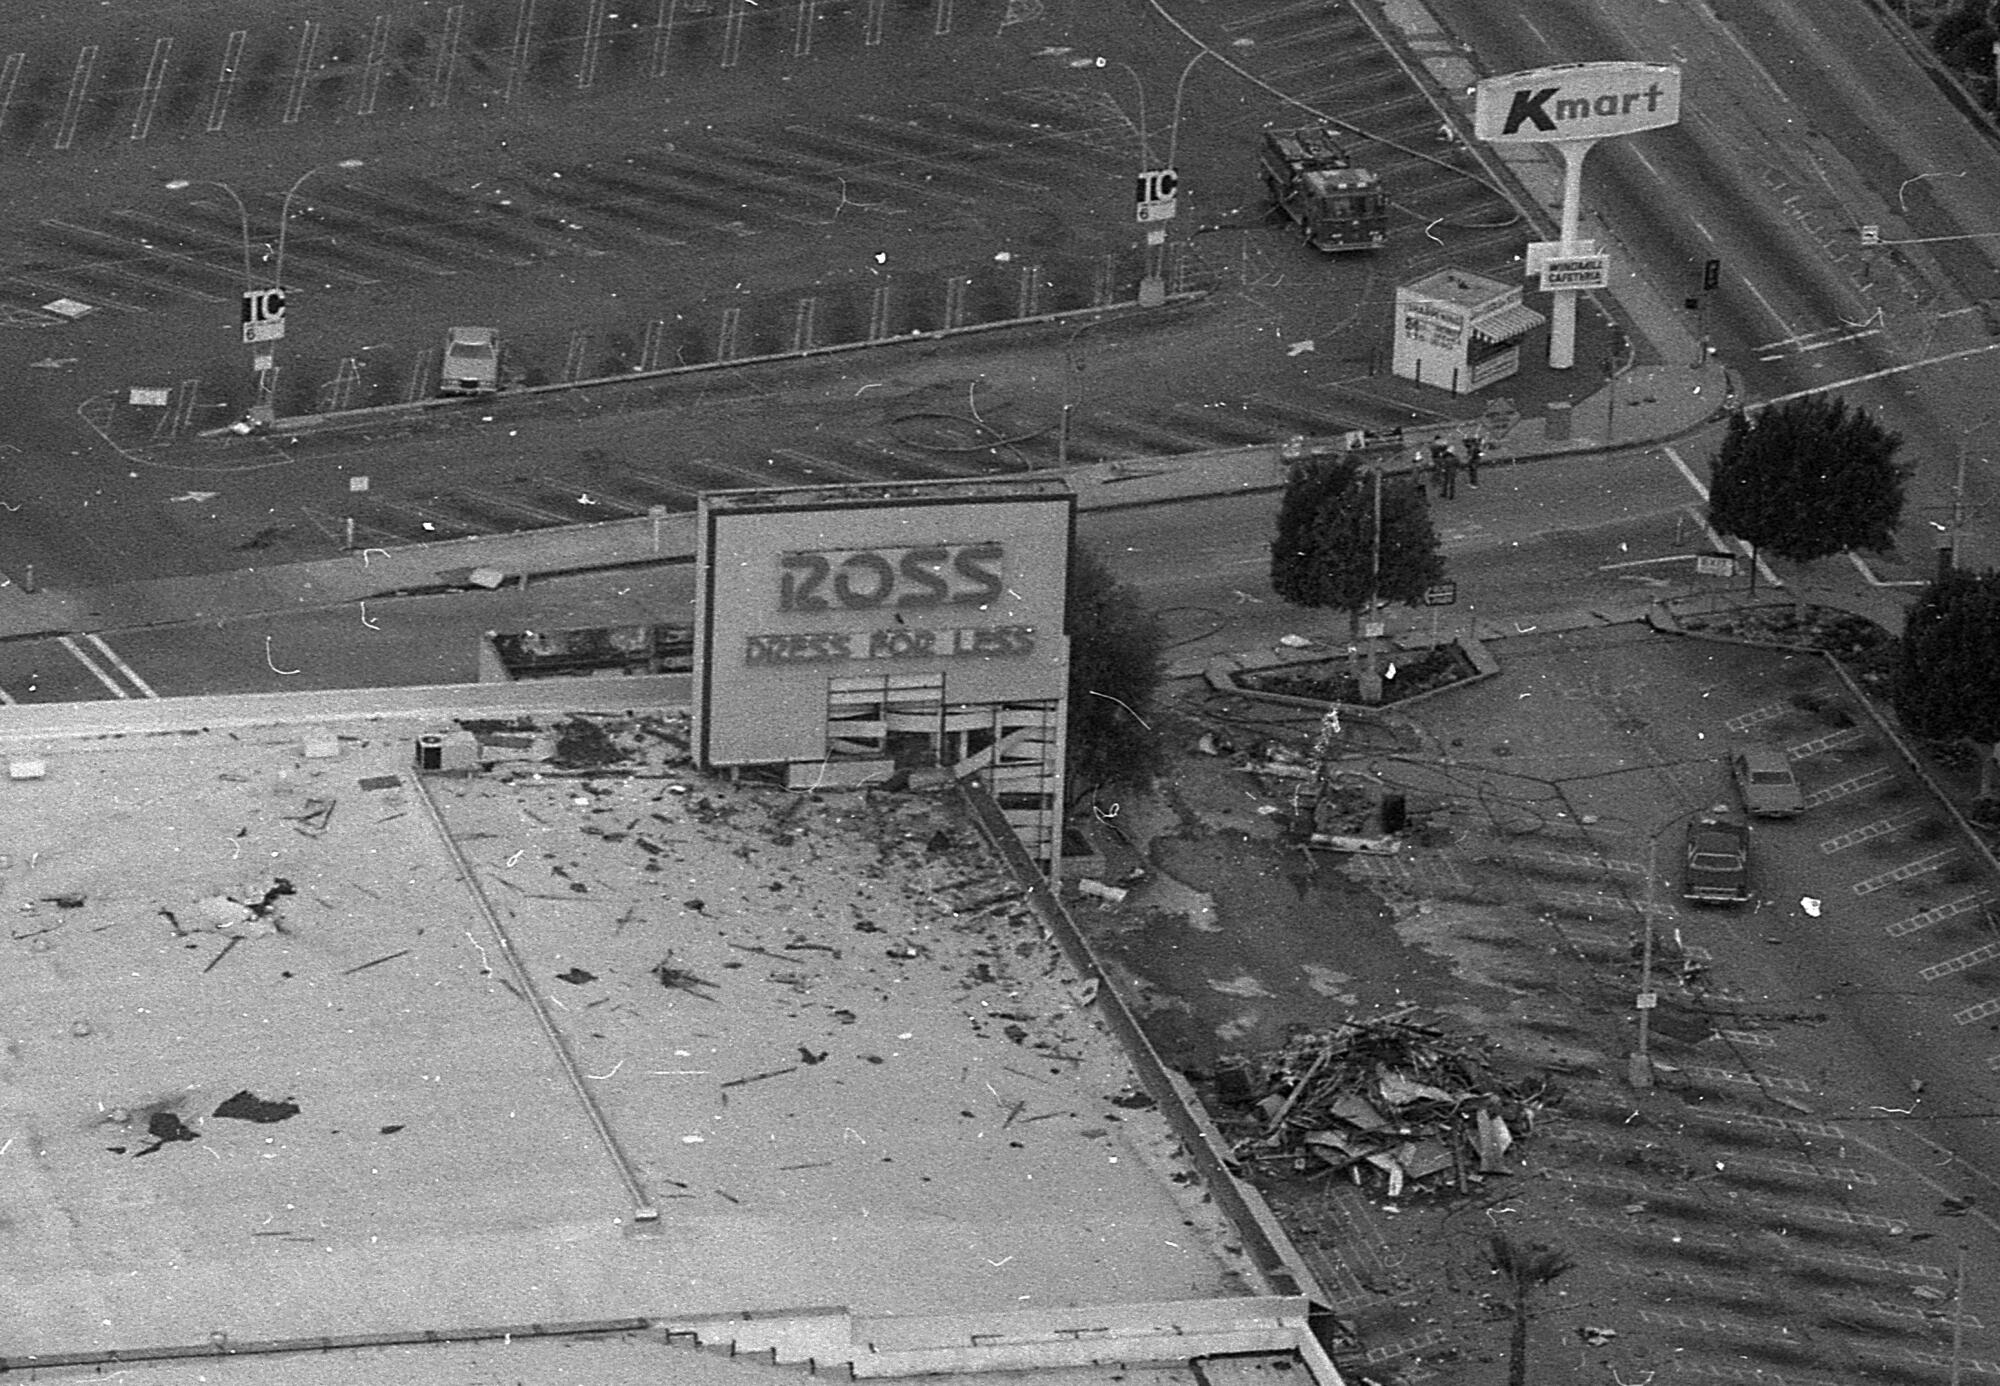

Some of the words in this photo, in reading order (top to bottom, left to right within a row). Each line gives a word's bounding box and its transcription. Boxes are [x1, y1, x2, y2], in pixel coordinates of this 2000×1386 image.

[1502, 83, 1664, 135] Kmart
[1138, 170, 1178, 203] TC
[243, 288, 286, 322] TC
[781, 546, 1003, 612] ROSS
[746, 633, 850, 665] DRESS
[870, 629, 936, 659] FOR
[953, 625, 1035, 657] LESS
